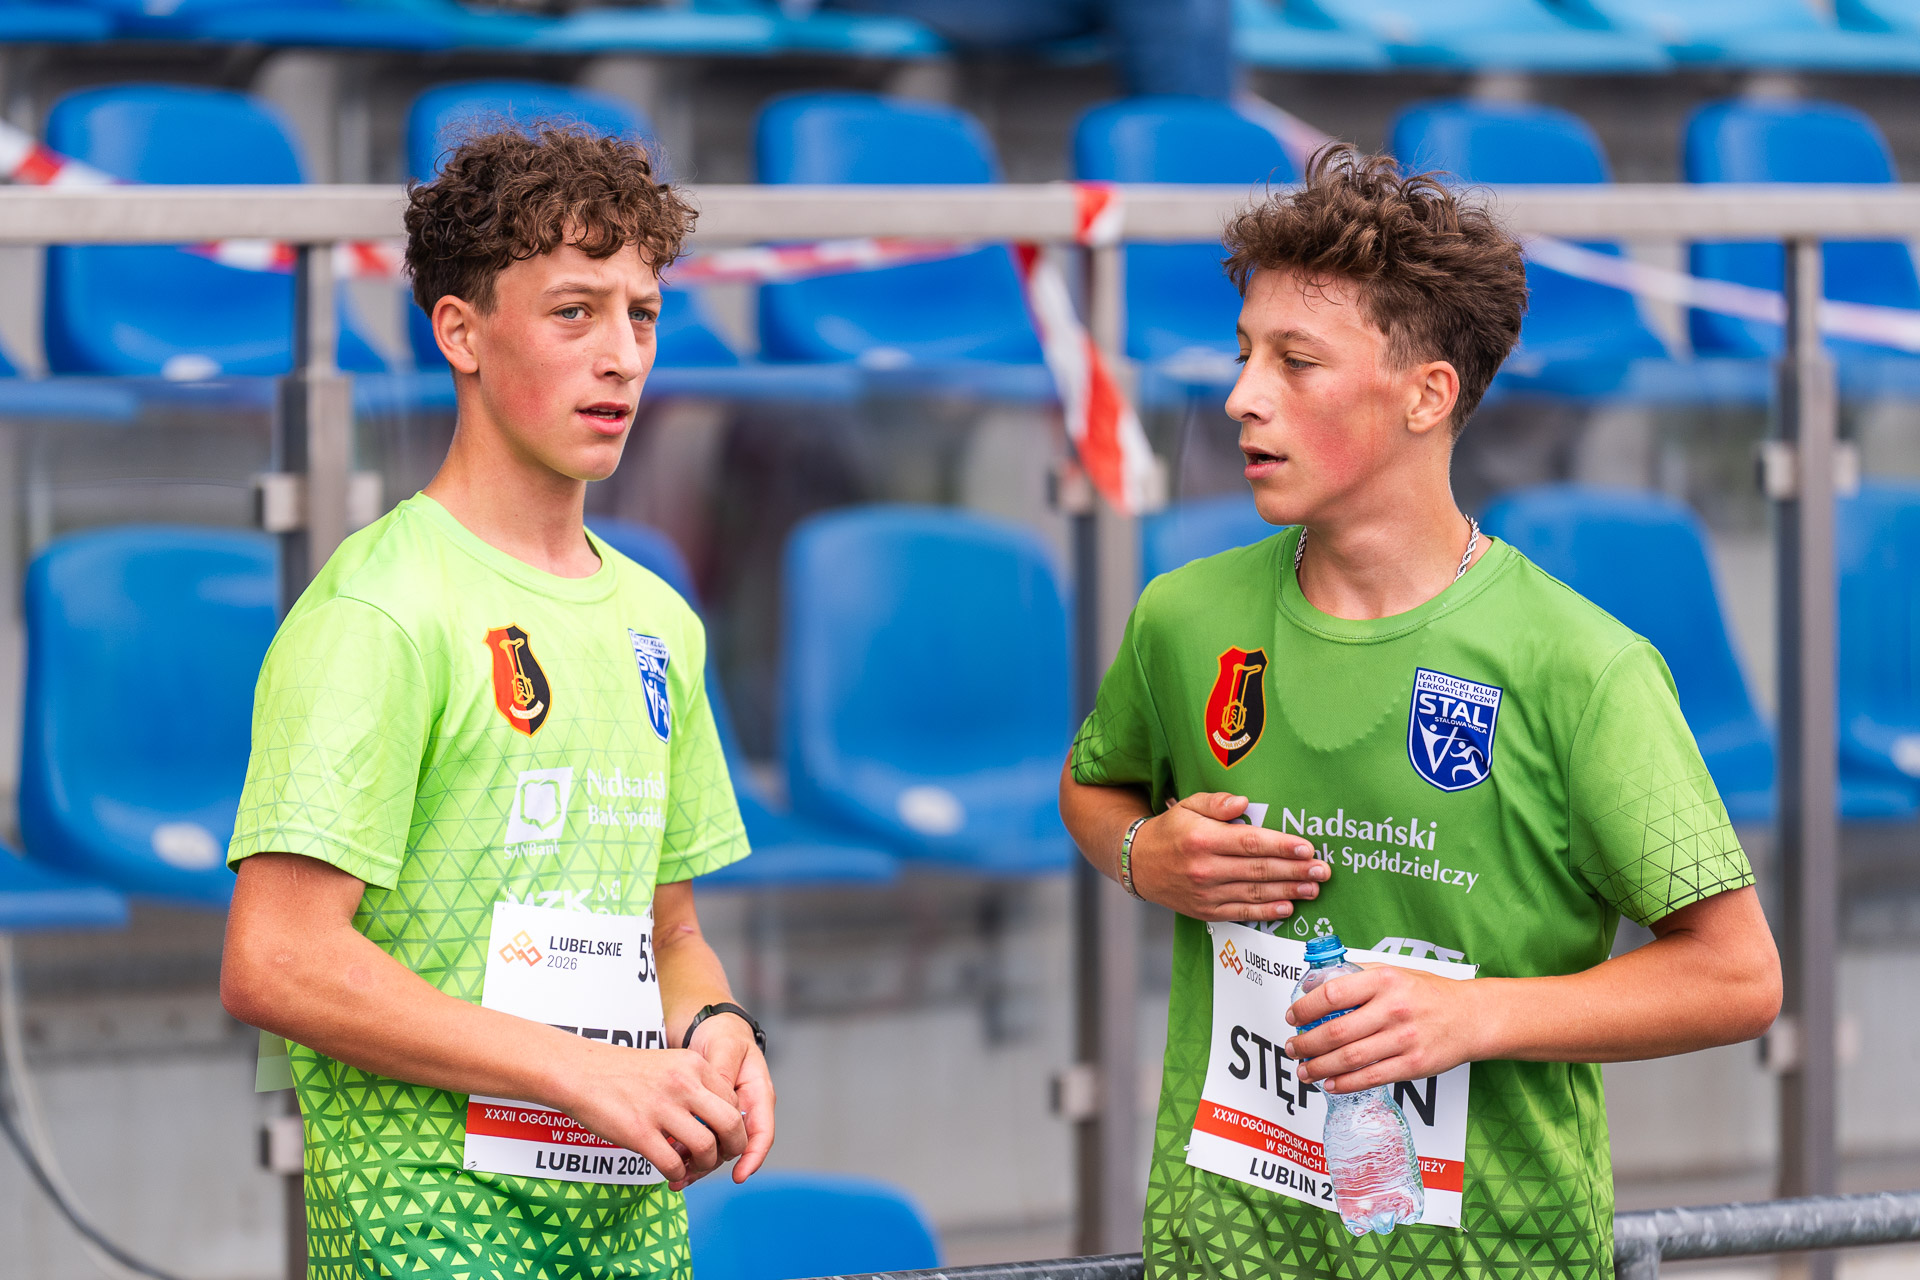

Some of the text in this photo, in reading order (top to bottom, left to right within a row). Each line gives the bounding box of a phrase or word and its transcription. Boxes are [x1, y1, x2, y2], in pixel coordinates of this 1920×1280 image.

[1418, 681, 1497, 705] LEKKOATLETYCZNY
[1419, 672, 1498, 698] KATOLICKI KLUB
[1418, 692, 1488, 729] STAL
[1434, 716, 1488, 734] STALOWA WOLA
[1282, 807, 1438, 851] Nadsański
[1314, 843, 1480, 894] nk Spółdzielczy
[549, 935, 623, 957] LUBELSKIE
[547, 955, 578, 971] 2026
[1244, 948, 1302, 981] LUBELSKIE
[1245, 966, 1263, 987] 2026
[484, 1108, 516, 1122] XXXII
[551, 1130, 564, 1142] W
[1212, 1107, 1240, 1126] XXXII
[1240, 1116, 1309, 1154] OGÓLNOPOLSKA
[535, 1150, 652, 1176] LUBLIN 2026
[1265, 1138, 1276, 1151] W
[1276, 1143, 1322, 1171] SPORTACH
[1249, 1157, 1316, 1197] LUBLIN
